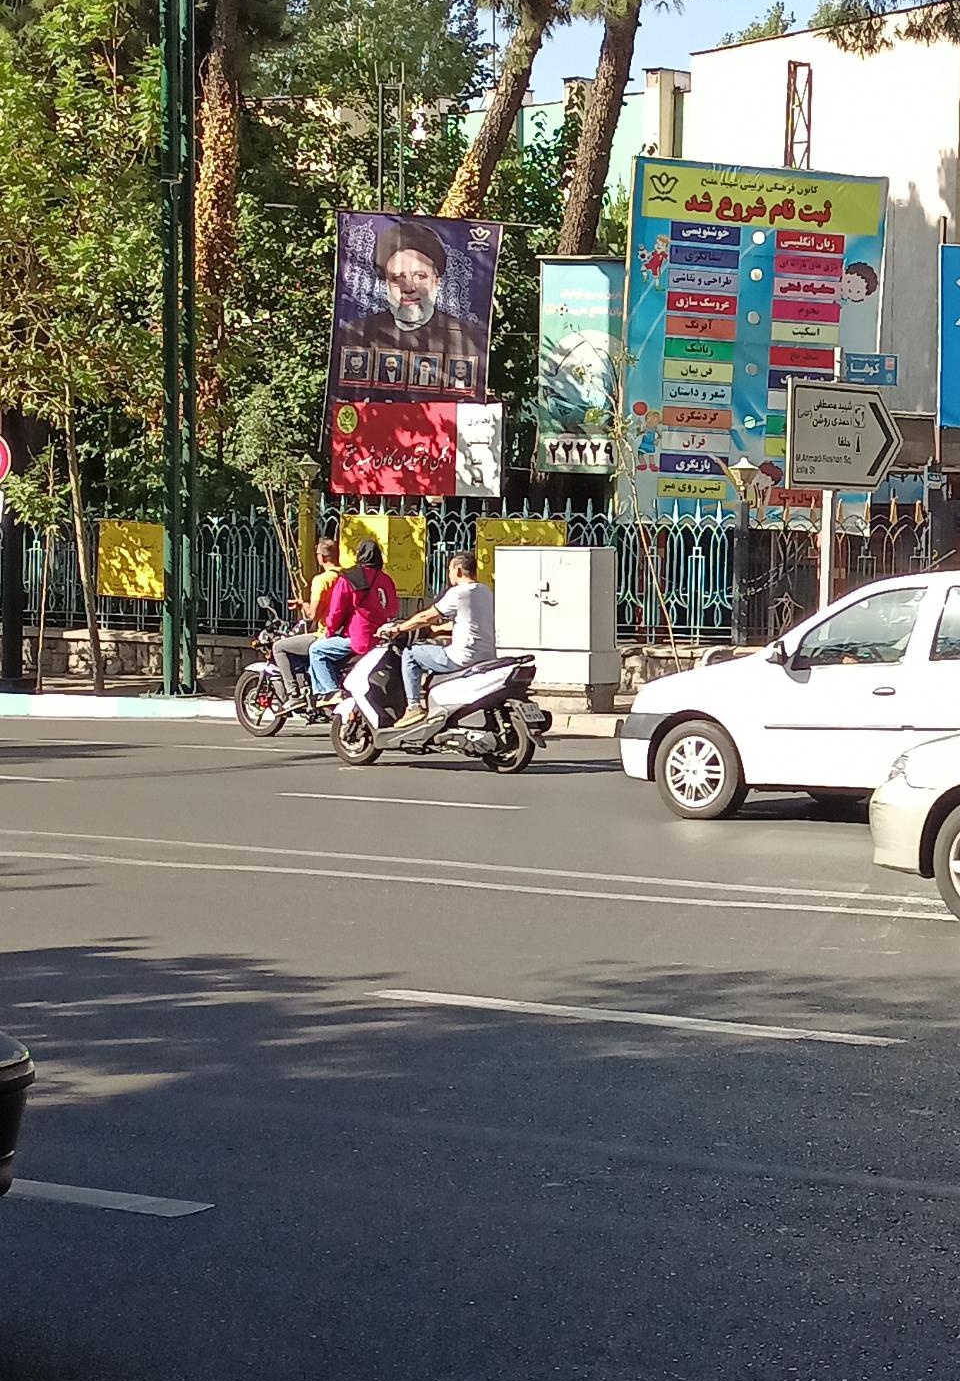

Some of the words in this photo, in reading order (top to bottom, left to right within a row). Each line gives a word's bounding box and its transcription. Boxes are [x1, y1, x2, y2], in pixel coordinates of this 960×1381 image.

[685, 191, 713, 212] شد
[716, 196, 767, 223] شروع
[769, 198, 796, 225] نام
[799, 200, 832, 227] ثبت
[682, 226, 729, 240] خوشنویسی
[780, 236, 814, 248] انگلیسی
[816, 238, 835, 251] زبان
[672, 273, 695, 284] نقاشی
[704, 276, 732, 288] طراحی
[676, 296, 698, 308] سازی
[700, 298, 729, 310] عروسک
[792, 326, 819, 338] اسکیت
[685, 343, 713, 356] رباتیک
[681, 364, 698, 376] بیان
[701, 366, 713, 377] فن
[669, 386, 699, 398] داستان
[701, 391, 706, 400] و
[709, 389, 725, 401] شعر
[813, 399, 837, 411] مصطفی
[838, 400, 852, 413] شهید
[676, 411, 718, 424] گردشگری
[812, 414, 831, 427] روشن
[831, 417, 852, 427] احمدی
[683, 435, 706, 448] قرآن
[373, 447, 398, 469] کانون
[676, 459, 710, 472] بازیگری
[663, 483, 675, 492] میز
[678, 483, 697, 493] روی
[699, 482, 720, 493] تنیس
